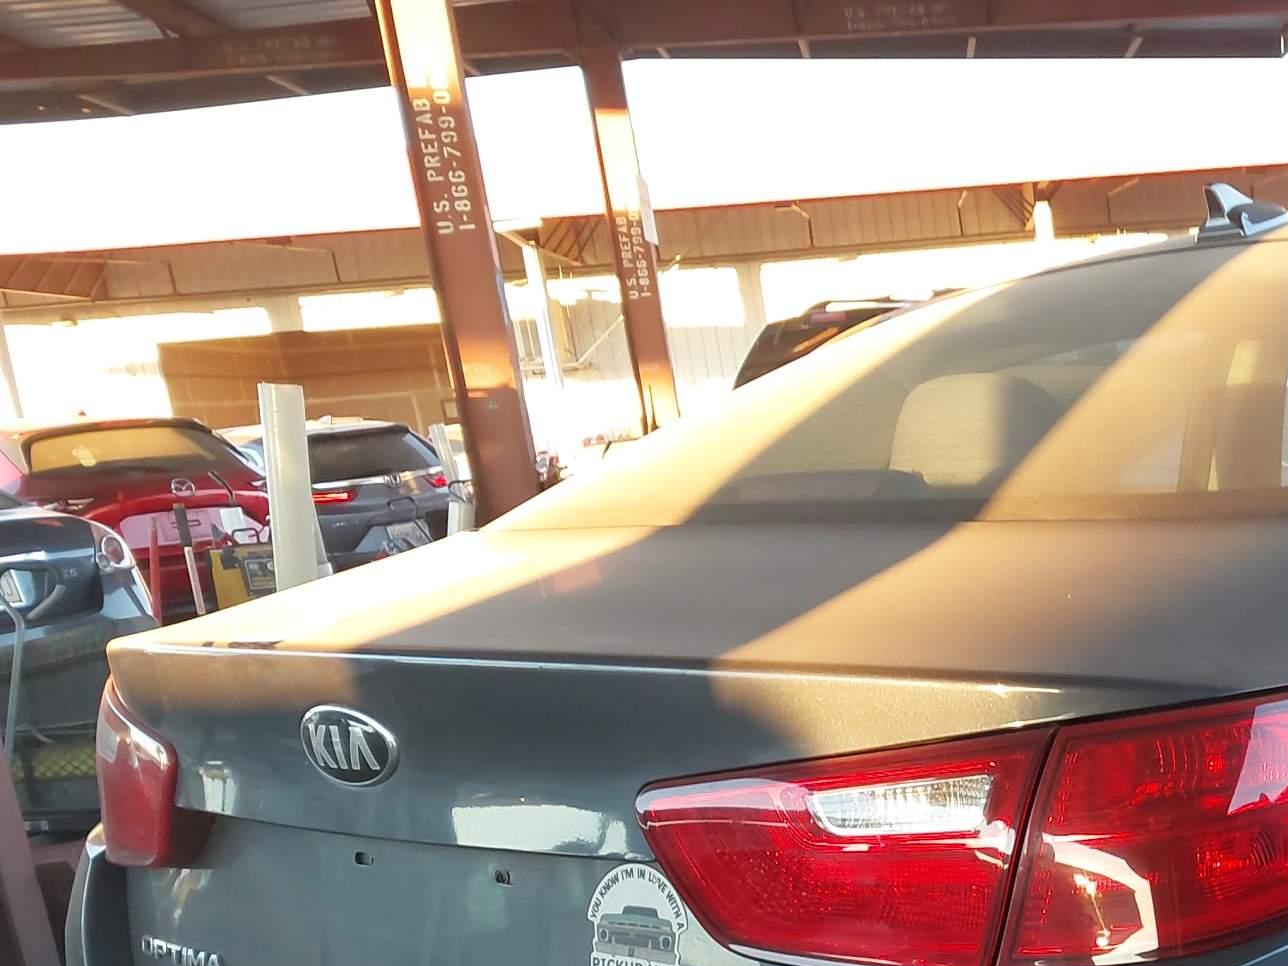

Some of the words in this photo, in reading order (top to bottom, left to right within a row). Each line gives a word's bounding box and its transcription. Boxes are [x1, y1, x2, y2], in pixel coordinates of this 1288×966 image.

[412, 97, 444, 182] PREFAB
[615, 216, 634, 268] PREFAB
[307, 723, 381, 770] KIA
[590, 898, 602, 919] YOU
[600, 873, 620, 899] KNOW
[620, 868, 634, 880] I'M
[637, 867, 646, 880] IN
[648, 872, 668, 893] LOVE
[666, 890, 681, 919] WITH
[676, 922, 685, 931] A
